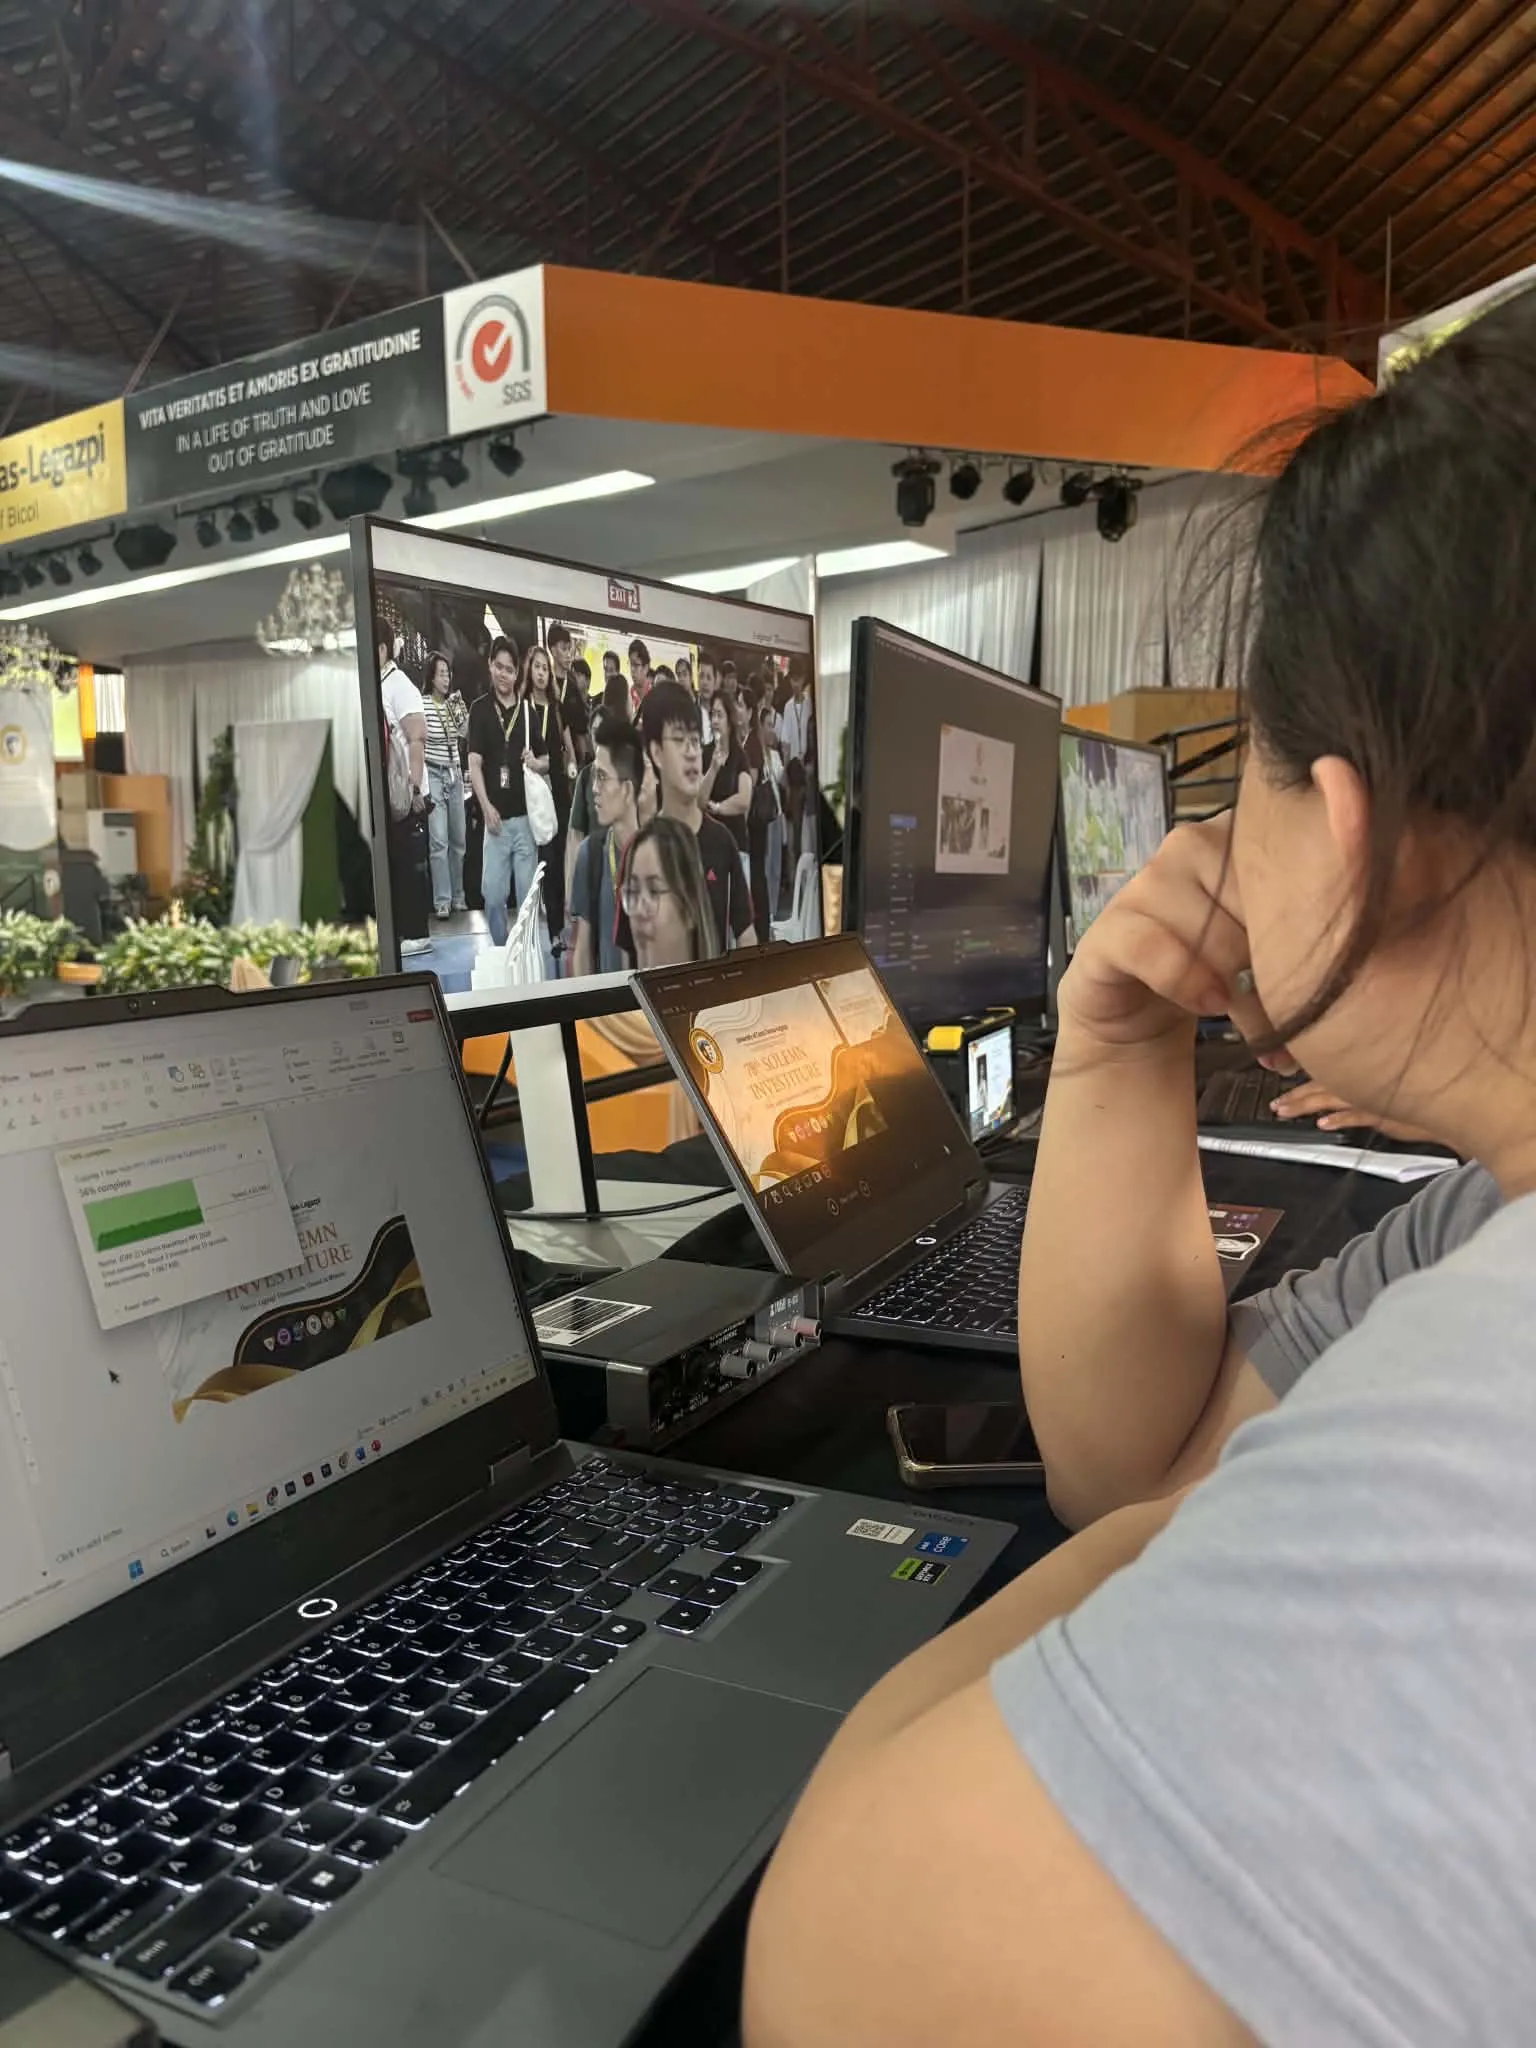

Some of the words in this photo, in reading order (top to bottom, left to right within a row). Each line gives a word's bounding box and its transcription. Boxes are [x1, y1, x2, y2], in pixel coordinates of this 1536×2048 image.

[139, 405, 166, 430] VITA
[165, 386, 227, 421] VERITATIS
[227, 381, 245, 404] ET
[245, 366, 299, 400] AMORIS
[300, 358, 320, 383] EX
[320, 327, 421, 376] GRATITUDINE
[503, 379, 532, 405] SGS
[176, 434, 190, 453] IN
[191, 430, 202, 449] A
[202, 422, 230, 447] LIFE
[230, 416, 250, 439] OF
[252, 405, 297, 433] TRUTH
[299, 394, 330, 421] AND
[331, 382, 372, 412] LOVE
[207, 449, 235, 473] OUT
[236, 444, 256, 466] OF
[257, 423, 335, 461] GRATITUDE
[7, 500, 39, 528] Bicol
[609, 585, 626, 603] EXIT
[750, 1062, 822, 1100] INVESTITURE
